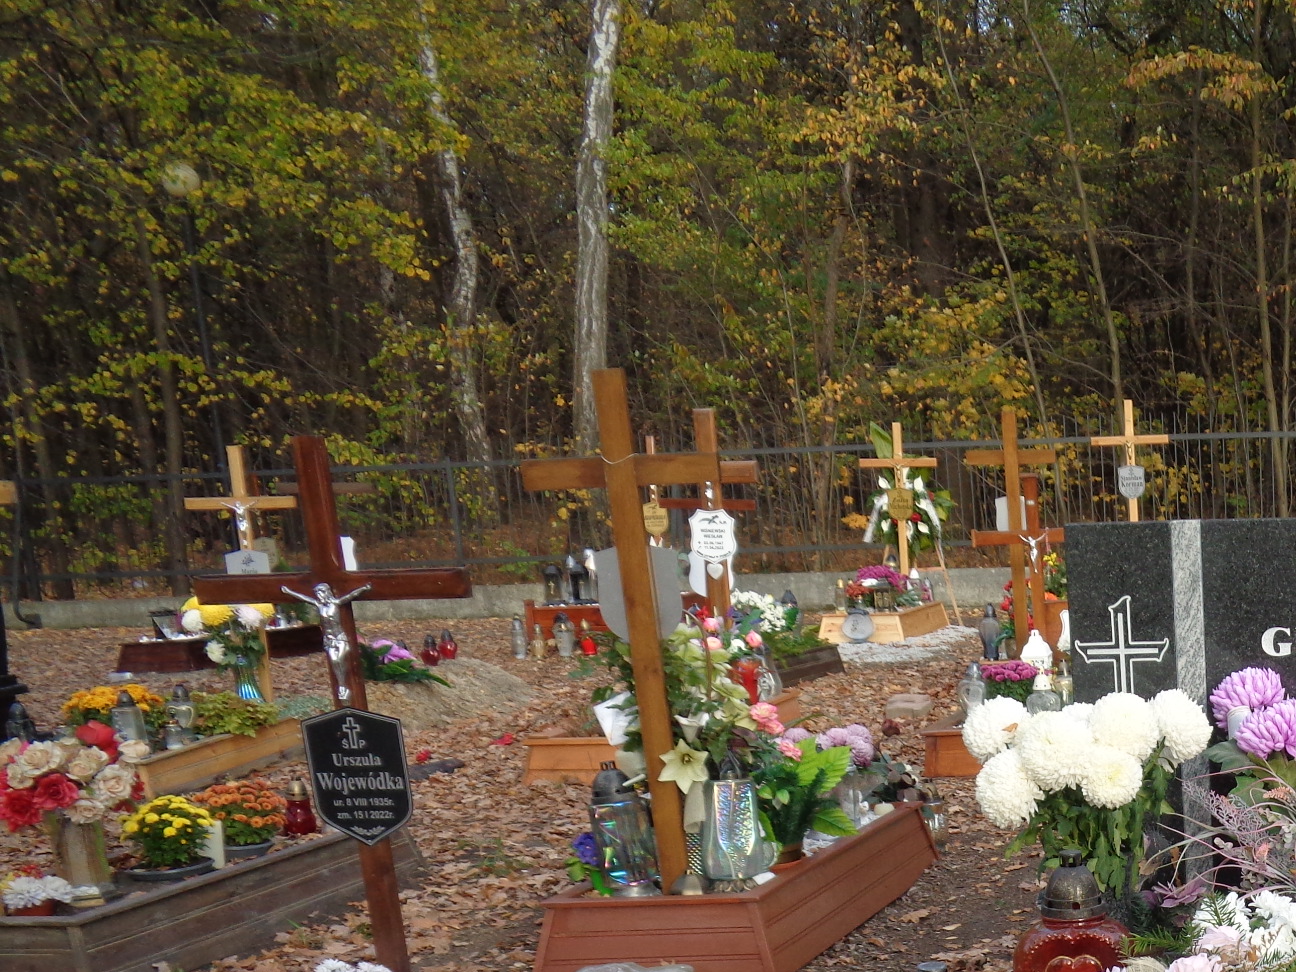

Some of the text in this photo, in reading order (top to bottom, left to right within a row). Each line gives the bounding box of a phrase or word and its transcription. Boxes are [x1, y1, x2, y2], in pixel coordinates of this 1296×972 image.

[332, 753, 382, 767] Urszula
[316, 771, 404, 795] Wojewódka
[353, 798, 367, 806] VIII
[353, 811, 363, 819] 15
